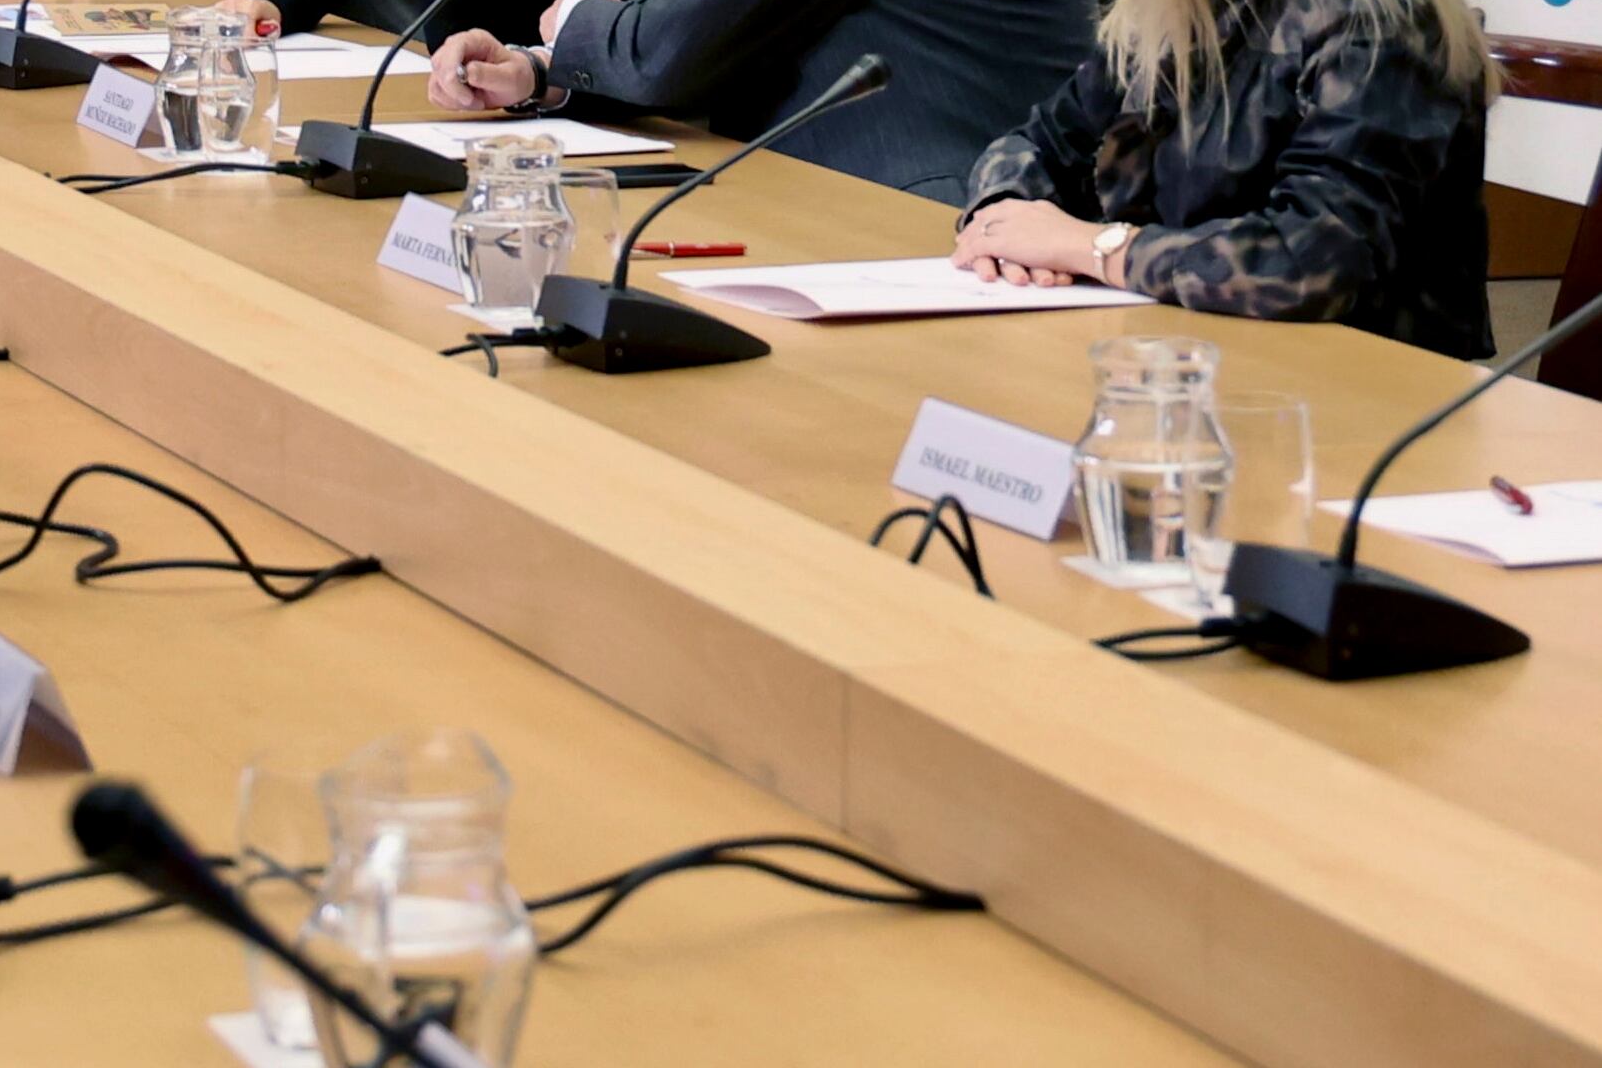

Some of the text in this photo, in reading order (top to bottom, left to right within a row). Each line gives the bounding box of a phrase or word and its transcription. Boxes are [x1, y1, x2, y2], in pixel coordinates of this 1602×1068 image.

[391, 231, 424, 256] MARTA
[919, 446, 1044, 505] ISMAEL MAESTRO
